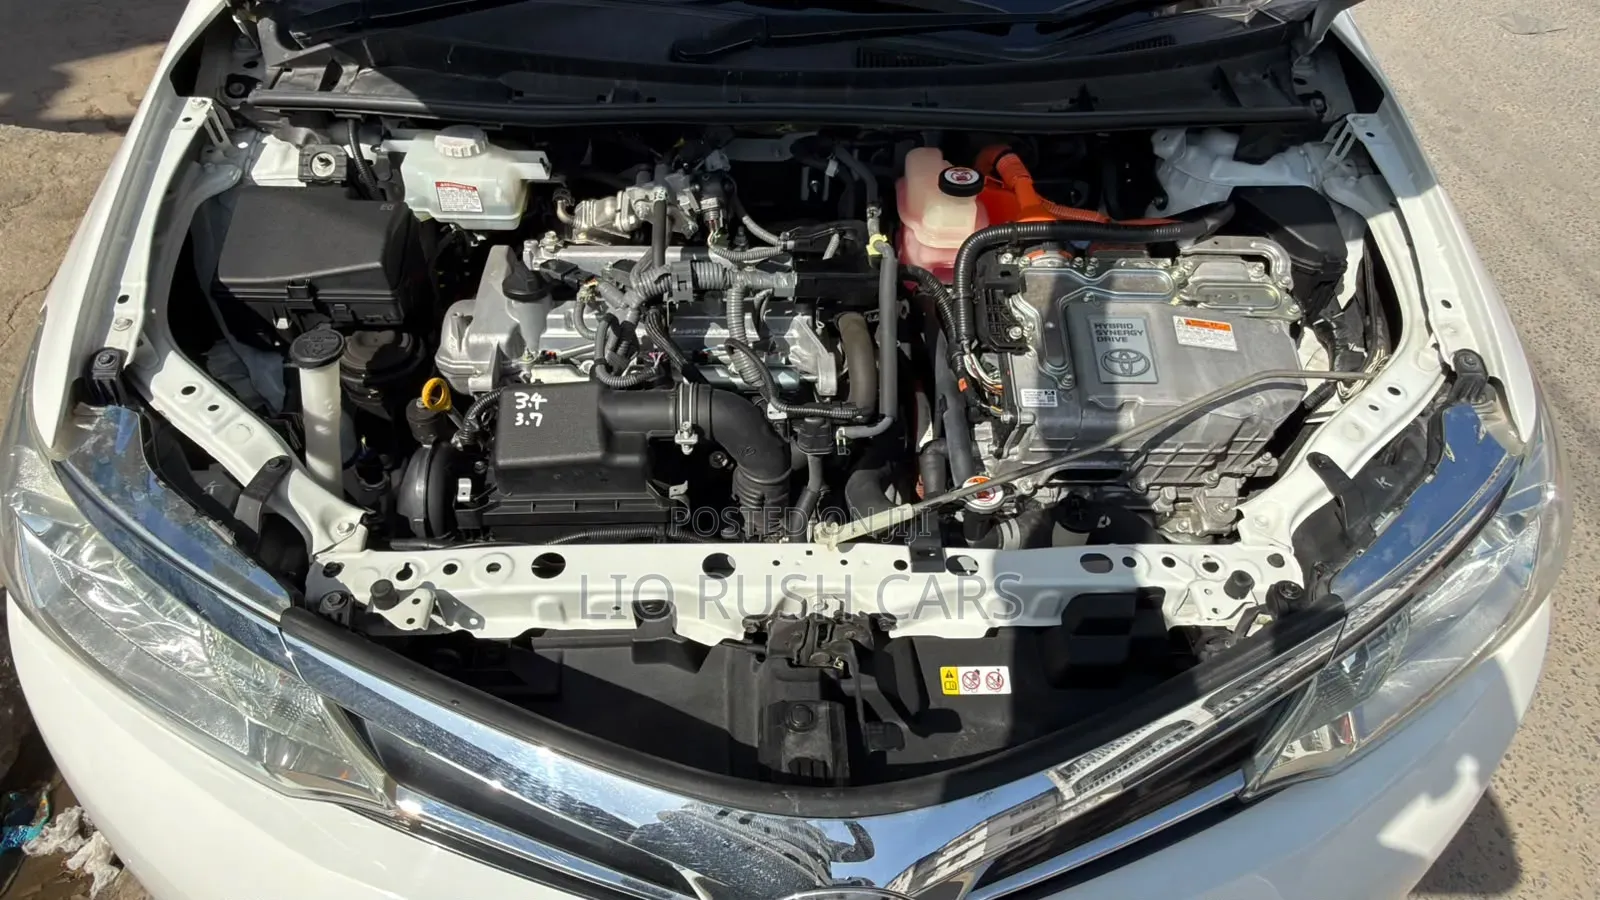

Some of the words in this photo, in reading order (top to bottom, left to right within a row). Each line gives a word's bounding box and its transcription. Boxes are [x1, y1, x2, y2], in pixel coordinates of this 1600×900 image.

[1094, 322, 1134, 330] HYBRID
[514, 391, 548, 410] 3.4
[514, 412, 543, 427] 3.7
